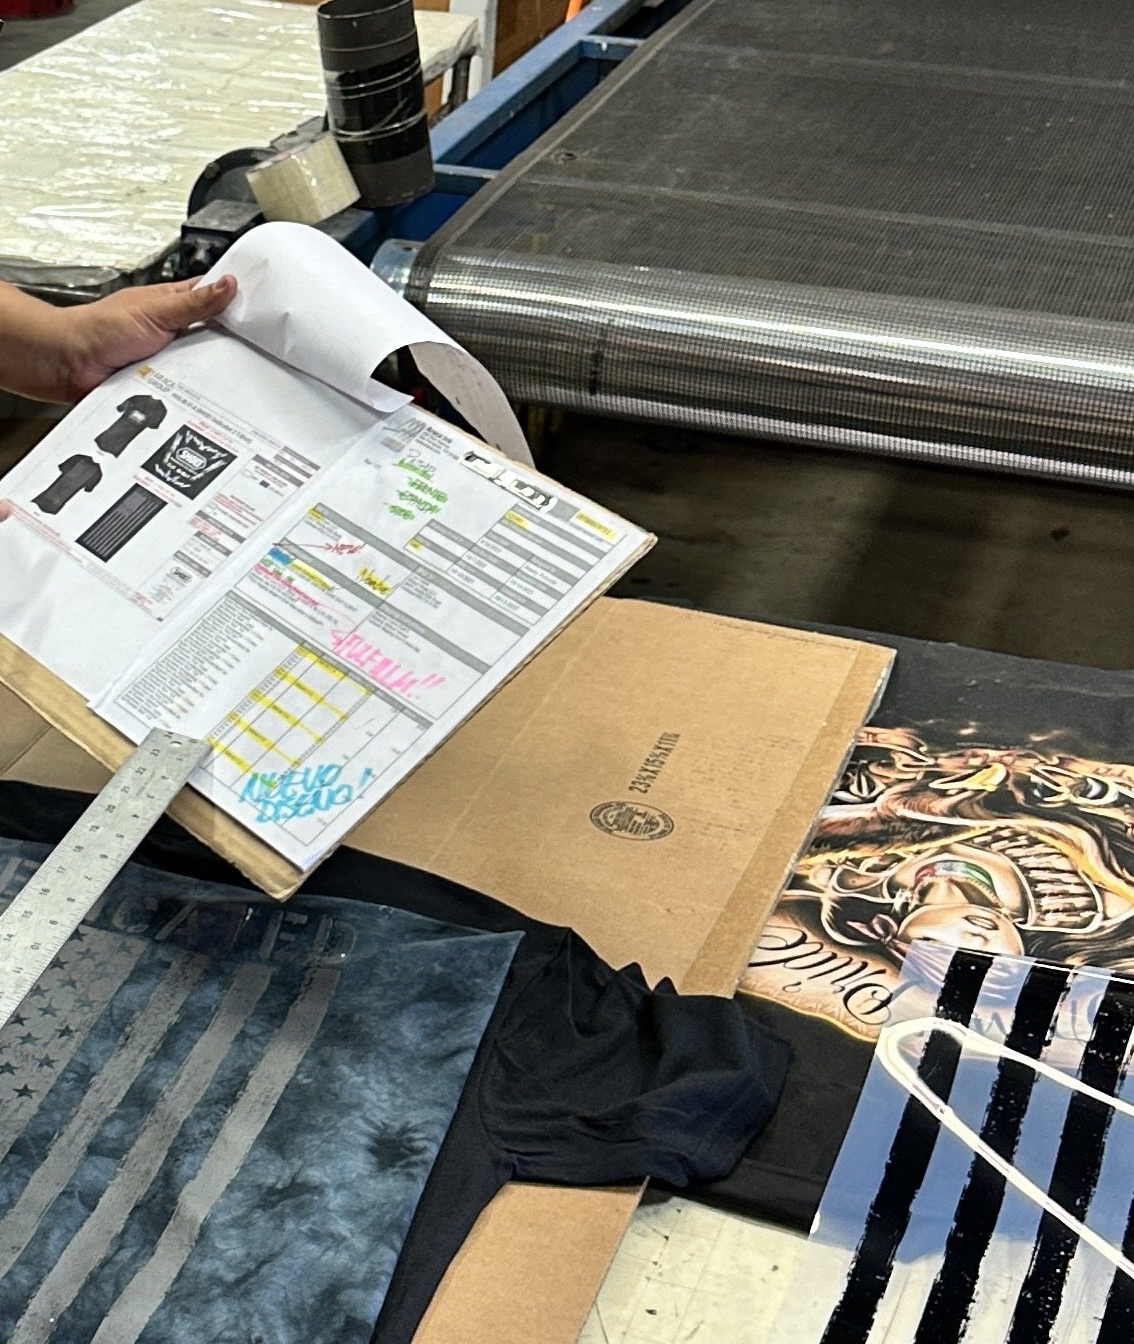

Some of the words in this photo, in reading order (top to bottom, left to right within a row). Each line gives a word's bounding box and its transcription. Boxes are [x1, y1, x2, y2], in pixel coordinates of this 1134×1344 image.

[3, 934, 15, 942] 14
[21, 910, 33, 919] 15
[39, 887, 51, 897] 16
[56, 866, 67, 874] 17
[73, 845, 85, 853] 18
[89, 824, 101, 834] 19
[105, 804, 116, 814] 20
[120, 785, 131, 794] 21
[135, 765, 147, 776] 22
[151, 748, 162, 757] 23
[30, 941, 42, 950] 10
[12, 966, 24, 974] 11
